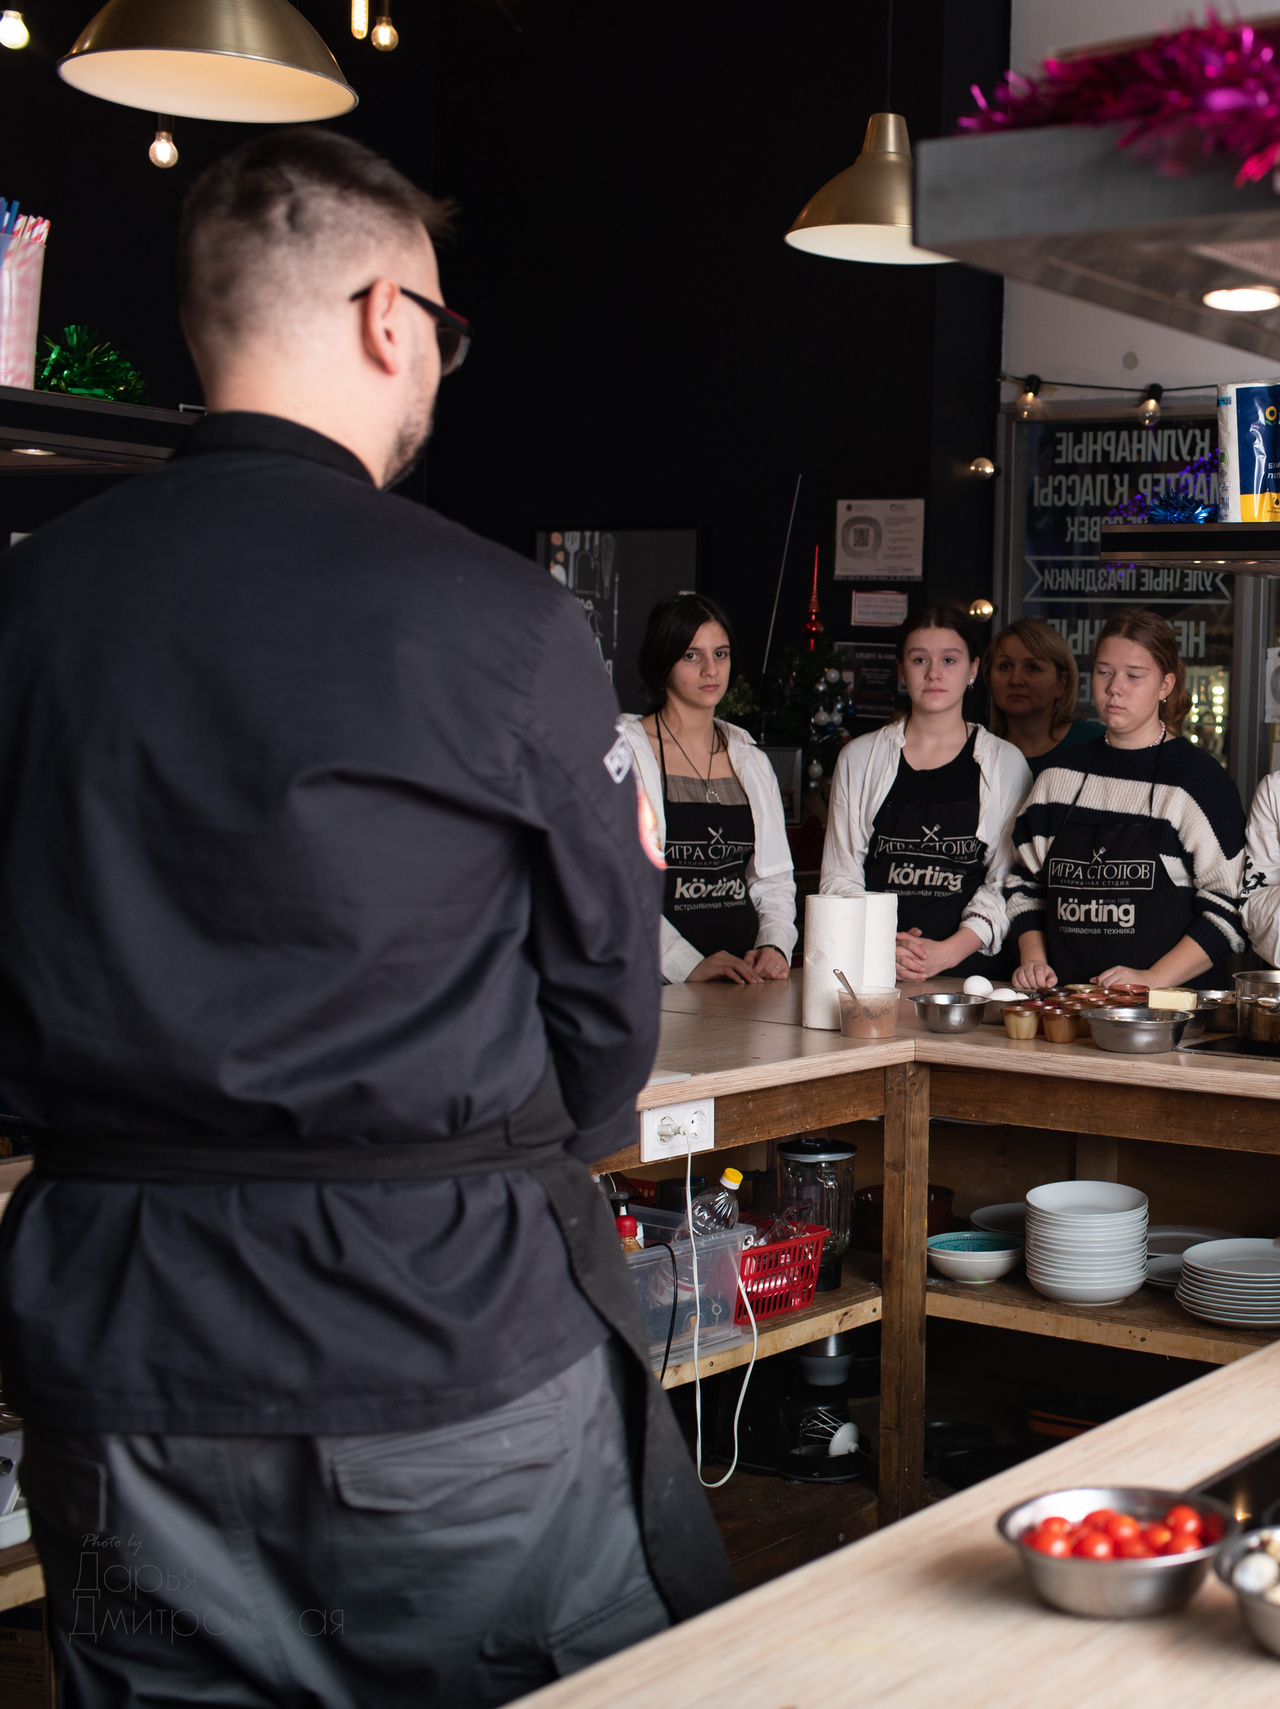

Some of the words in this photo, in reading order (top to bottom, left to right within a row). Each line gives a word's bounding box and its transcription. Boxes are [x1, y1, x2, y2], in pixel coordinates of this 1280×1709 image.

[887, 862, 964, 892] körting
[1052, 862, 1083, 880] ИГРА
[1087, 864, 1150, 880] СТОЛОВ
[674, 877, 746, 900] körting
[1057, 896, 1136, 928] körting
[1103, 927, 1135, 935] техника
